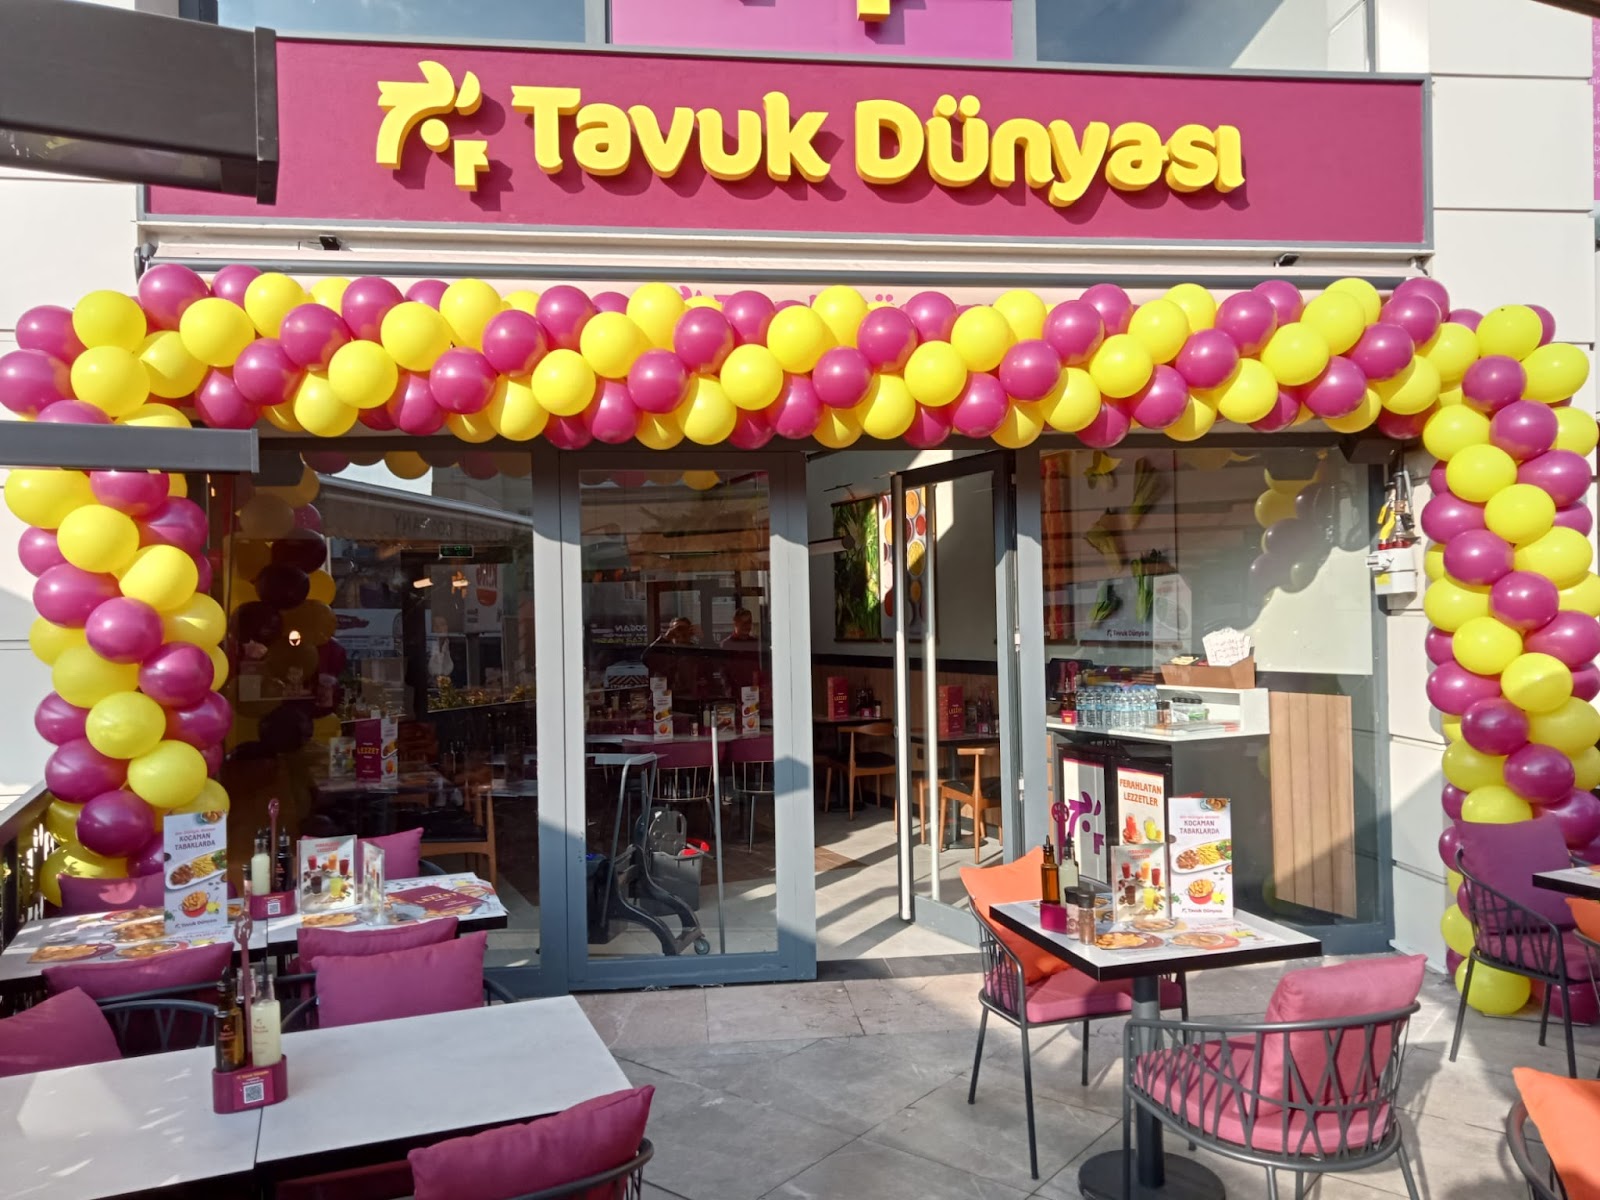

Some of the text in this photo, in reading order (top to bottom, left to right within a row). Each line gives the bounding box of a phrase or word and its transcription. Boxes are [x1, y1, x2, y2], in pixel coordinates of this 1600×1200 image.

[510, 85, 1246, 208] Tavuk Dünyası
[1119, 778, 1162, 795] FERAHLATAN
[1123, 791, 1158, 807] LEZZETLER
[175, 840, 216, 850] TABAKLARDA
[179, 832, 211, 843] KOCAMAN
